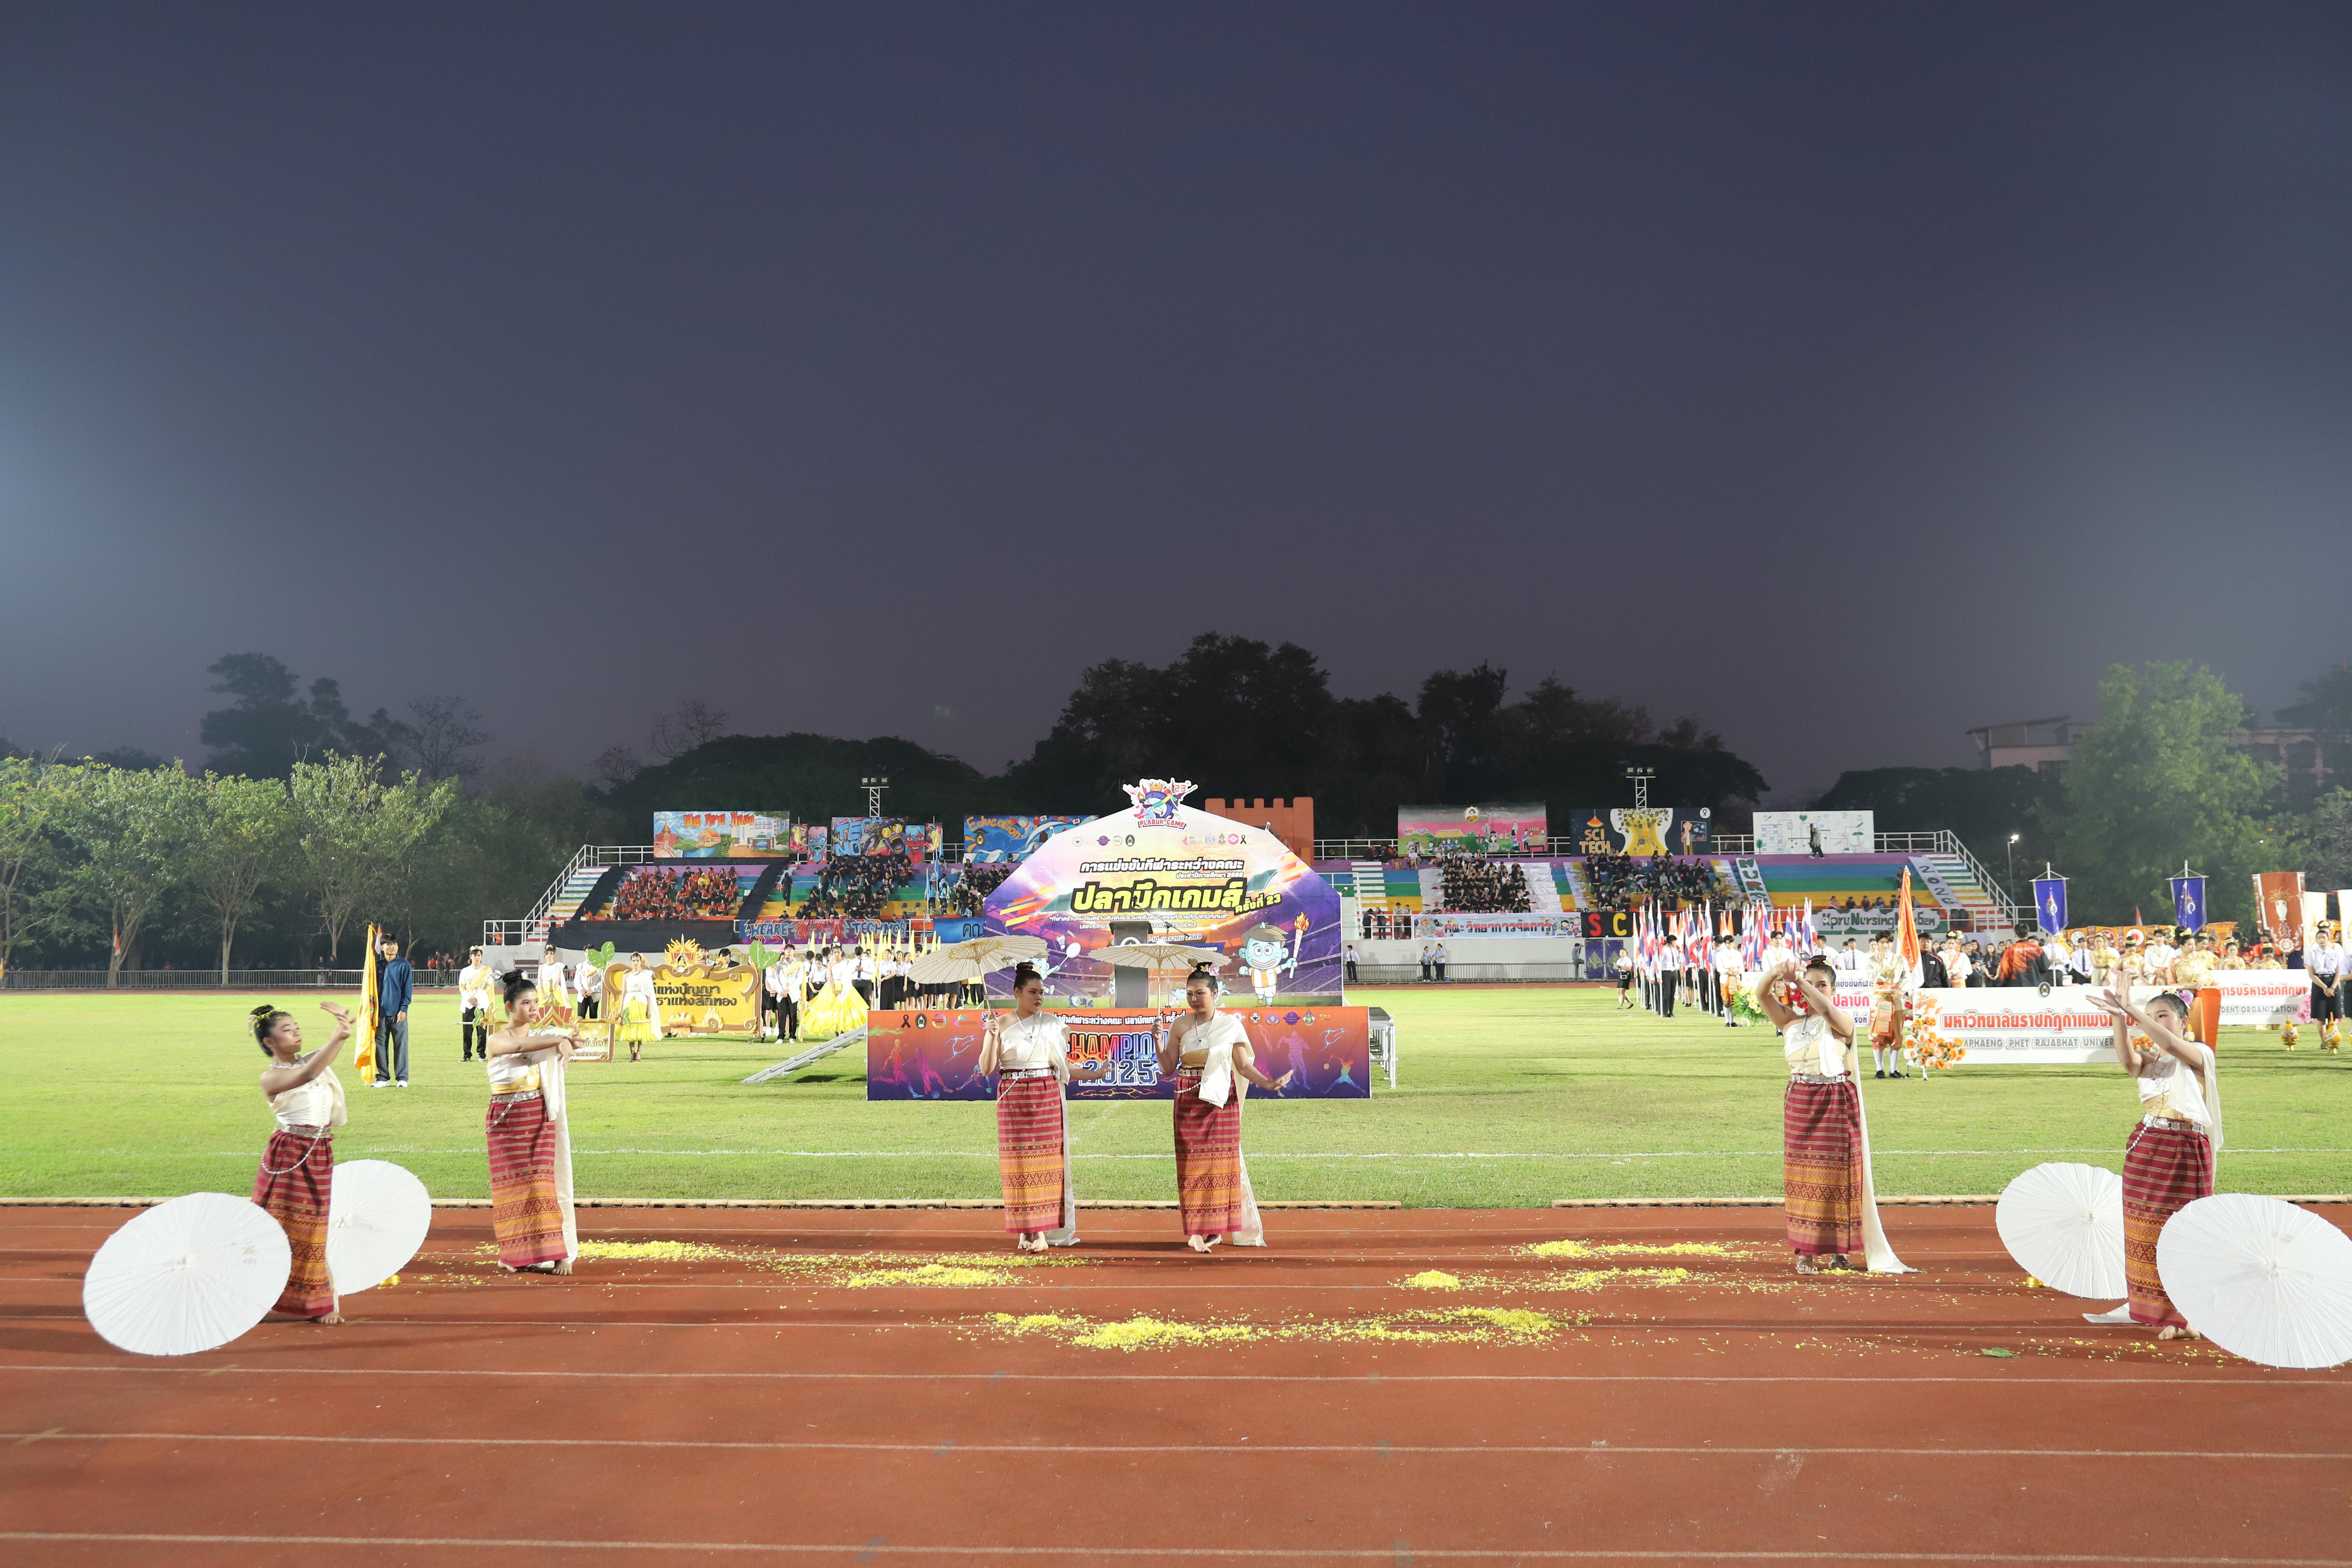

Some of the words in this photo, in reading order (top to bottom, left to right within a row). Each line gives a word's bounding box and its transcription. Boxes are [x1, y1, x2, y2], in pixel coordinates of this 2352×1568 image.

[966, 815, 1022, 839] Education
[1584, 828, 1605, 841] SCI
[835, 842, 861, 856] NO
[1579, 841, 1611, 854] TECH
[1080, 858, 1243, 872] การแข่งขันกีฬาระหว่างคณะ
[1738, 859, 1771, 907] NURS
[1074, 881, 1243, 910] ปลาบึกเกมส์
[1235, 894, 1264, 913] ครั้งที่
[1266, 893, 1282, 905] 23
[1067, 1033, 1168, 1061] HAMPIO
[1963, 1039, 2003, 1047] MPHAENG
[2009, 1038, 2029, 1047] PHET
[2035, 1038, 2078, 1047] RAJABHAT
[2083, 1038, 2115, 1047] UNIVER
